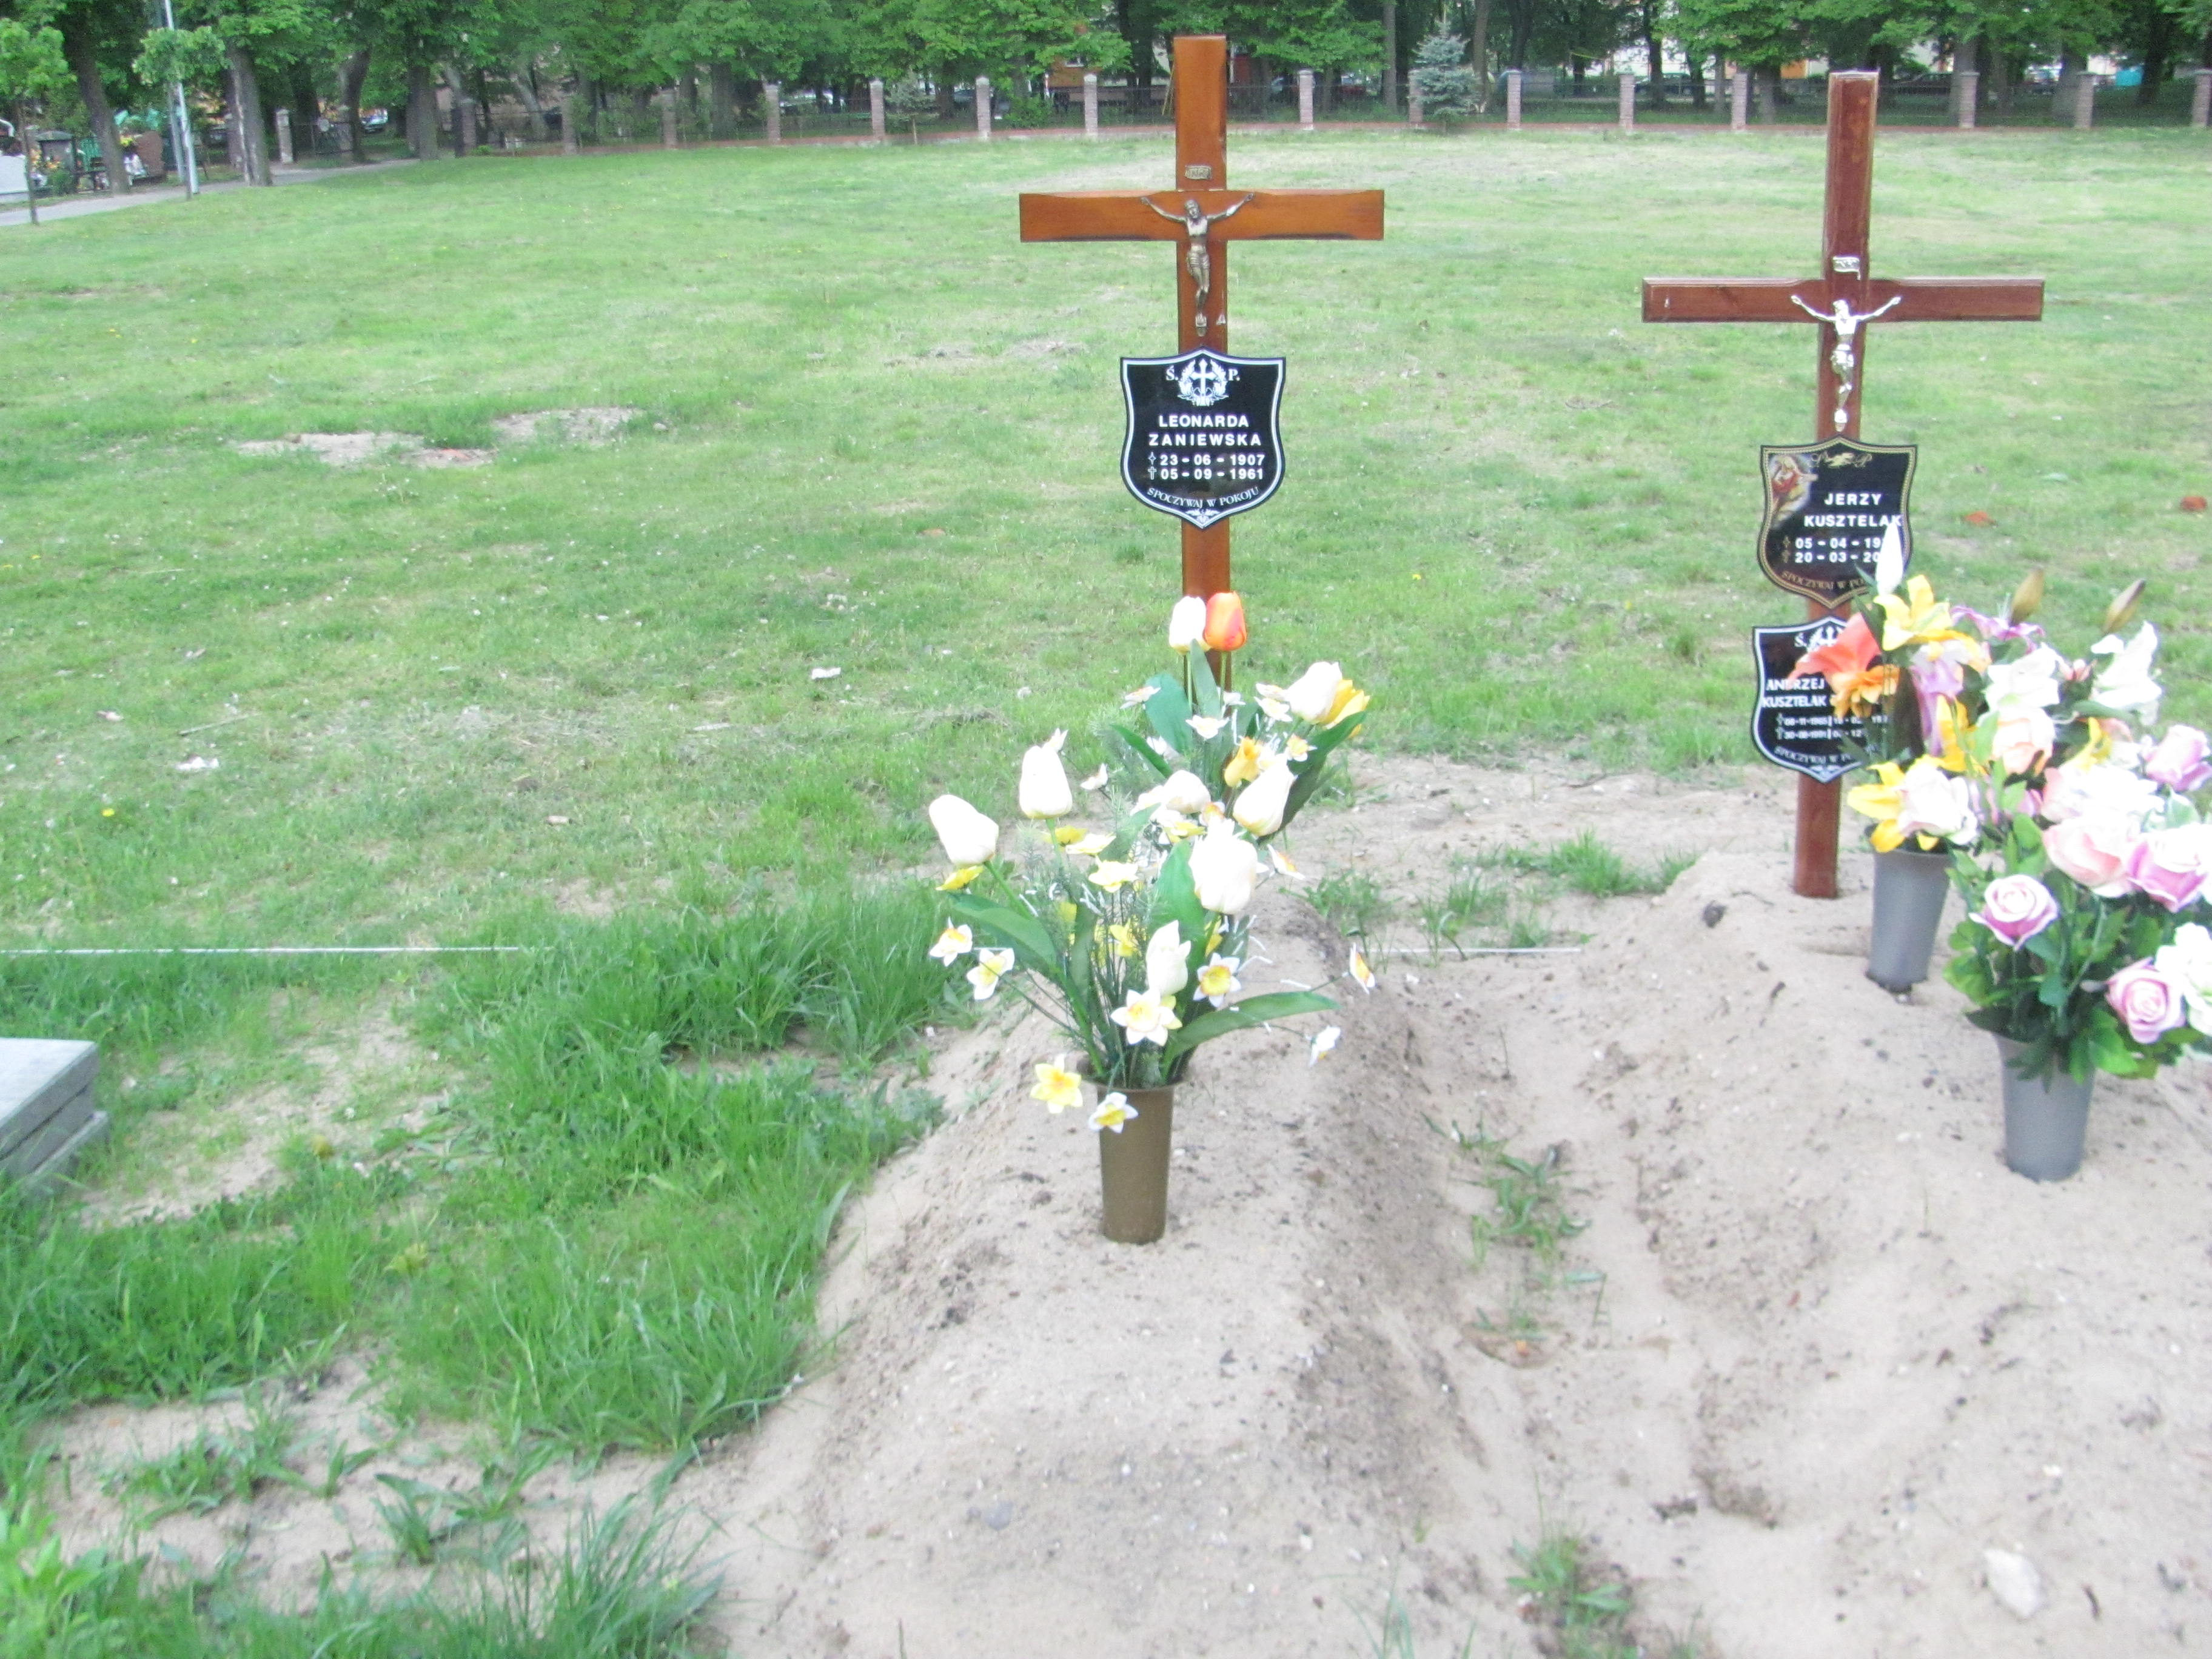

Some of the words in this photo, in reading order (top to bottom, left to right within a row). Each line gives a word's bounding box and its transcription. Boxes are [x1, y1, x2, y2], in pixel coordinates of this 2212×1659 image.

[1228, 369, 1240, 381] P.
[1159, 415, 1248, 427] LEONARDA
[1149, 434, 1261, 446] ZANIEWSKA
[1147, 487, 1203, 509] SPOCZYWAJ
[1219, 486, 1259, 506] POKOJU
[1825, 493, 1882, 505] JERZY
[1804, 515, 1902, 527] KUSZTELAK
[1864, 537, 1881, 549] 19
[1863, 552, 1880, 563] 20
[1763, 695, 1827, 707] KUSZTELAK
